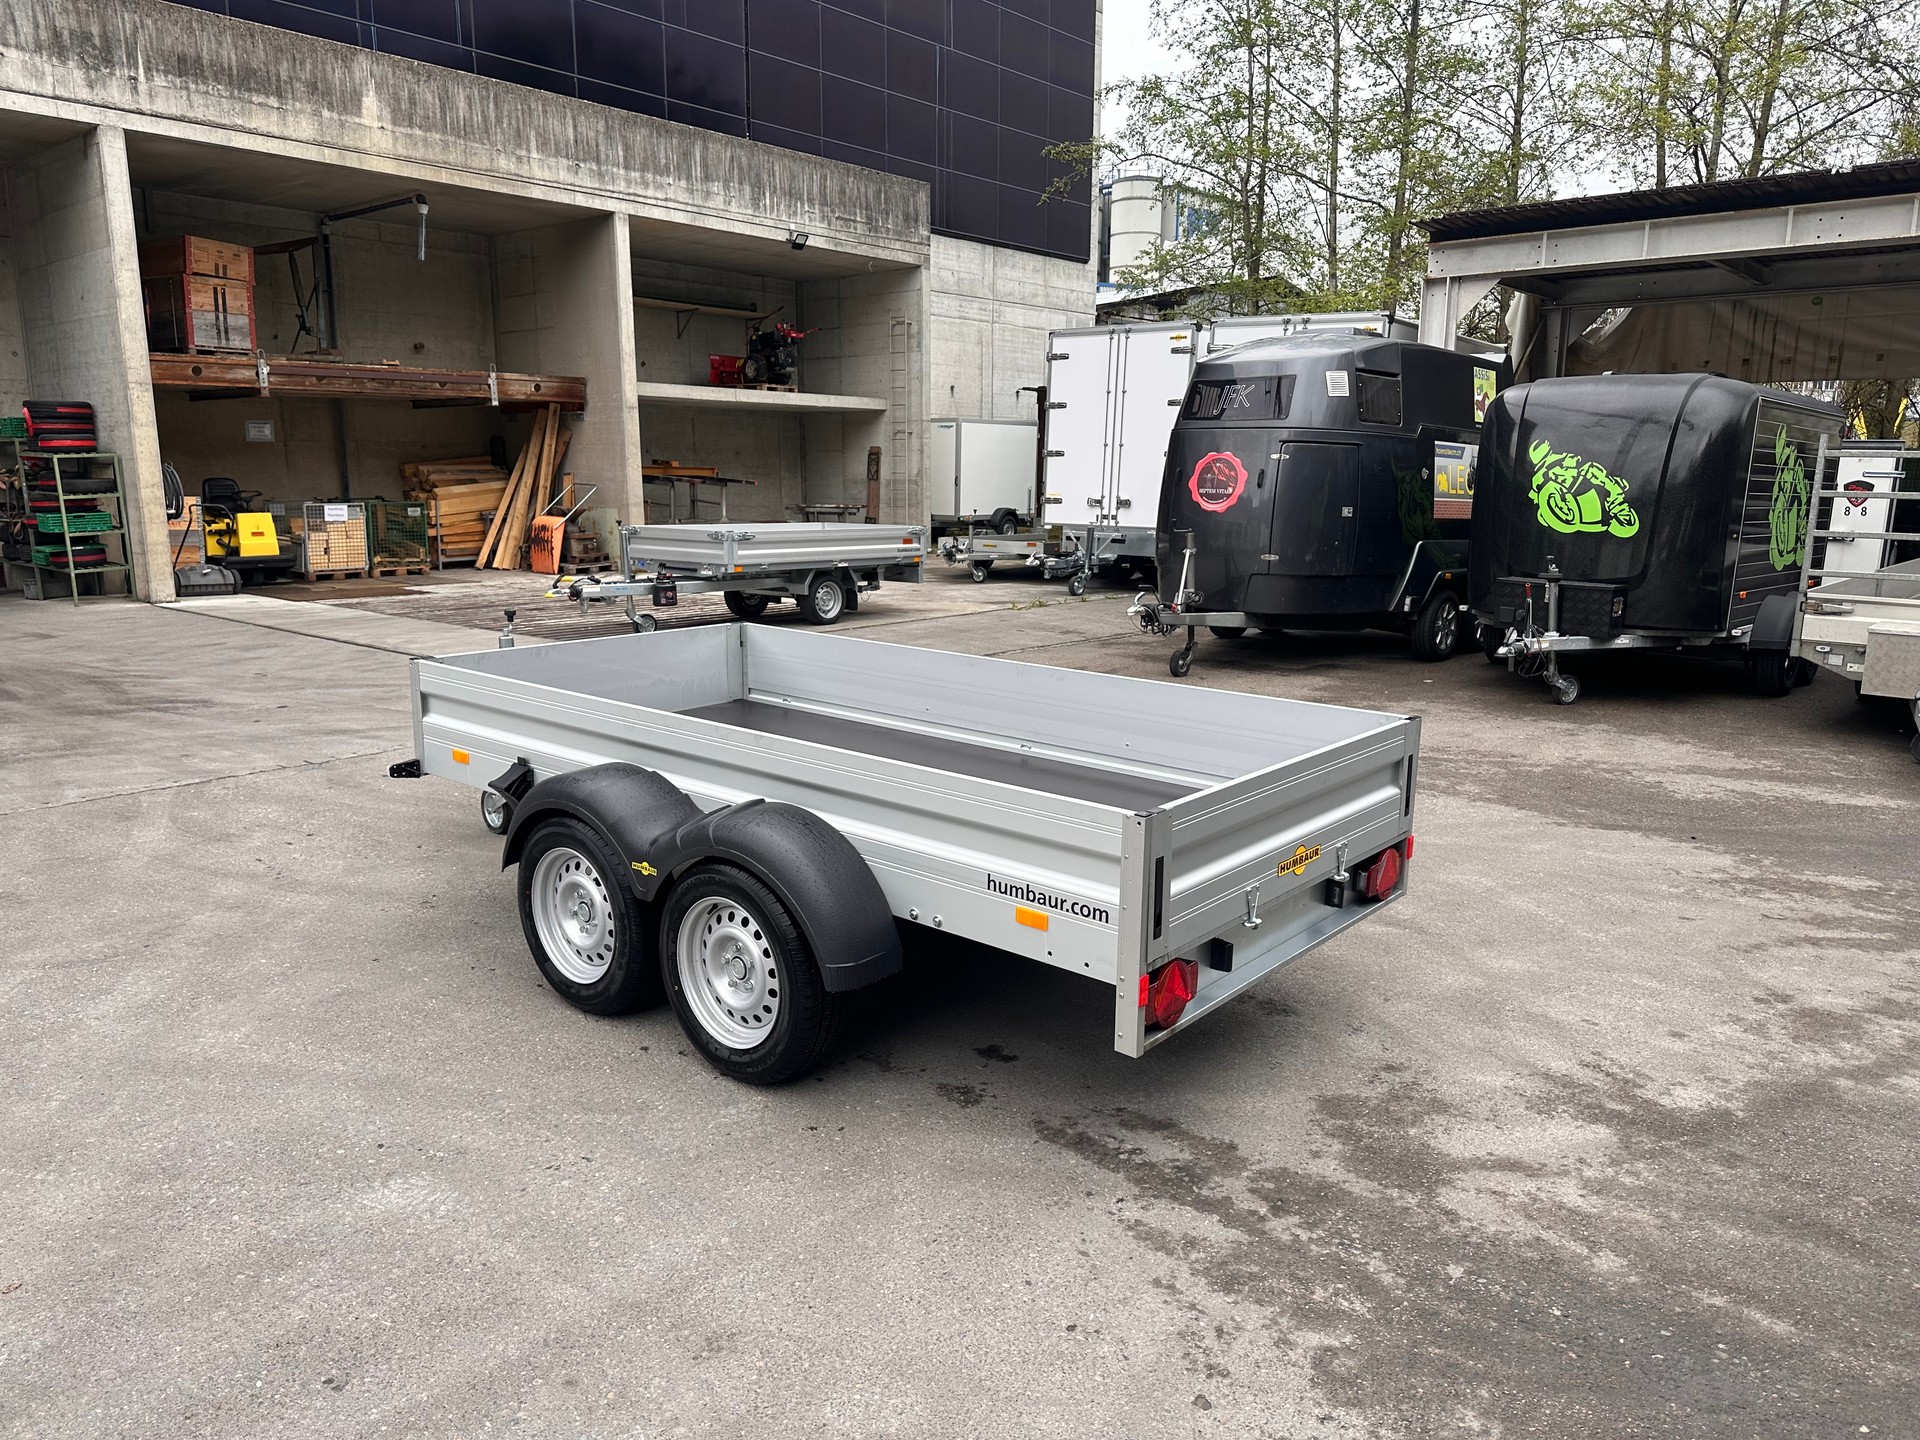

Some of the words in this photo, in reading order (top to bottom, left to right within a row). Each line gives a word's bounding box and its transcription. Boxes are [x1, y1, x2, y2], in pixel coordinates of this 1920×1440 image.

[1213, 385, 1255, 415] JFK
[1844, 506, 1851, 516] 8
[1860, 506, 1868, 517] 8
[633, 863, 656, 874] HUMBAUR
[1280, 847, 1320, 874] HUMBAUR
[987, 873, 1109, 924] humbaur.com
